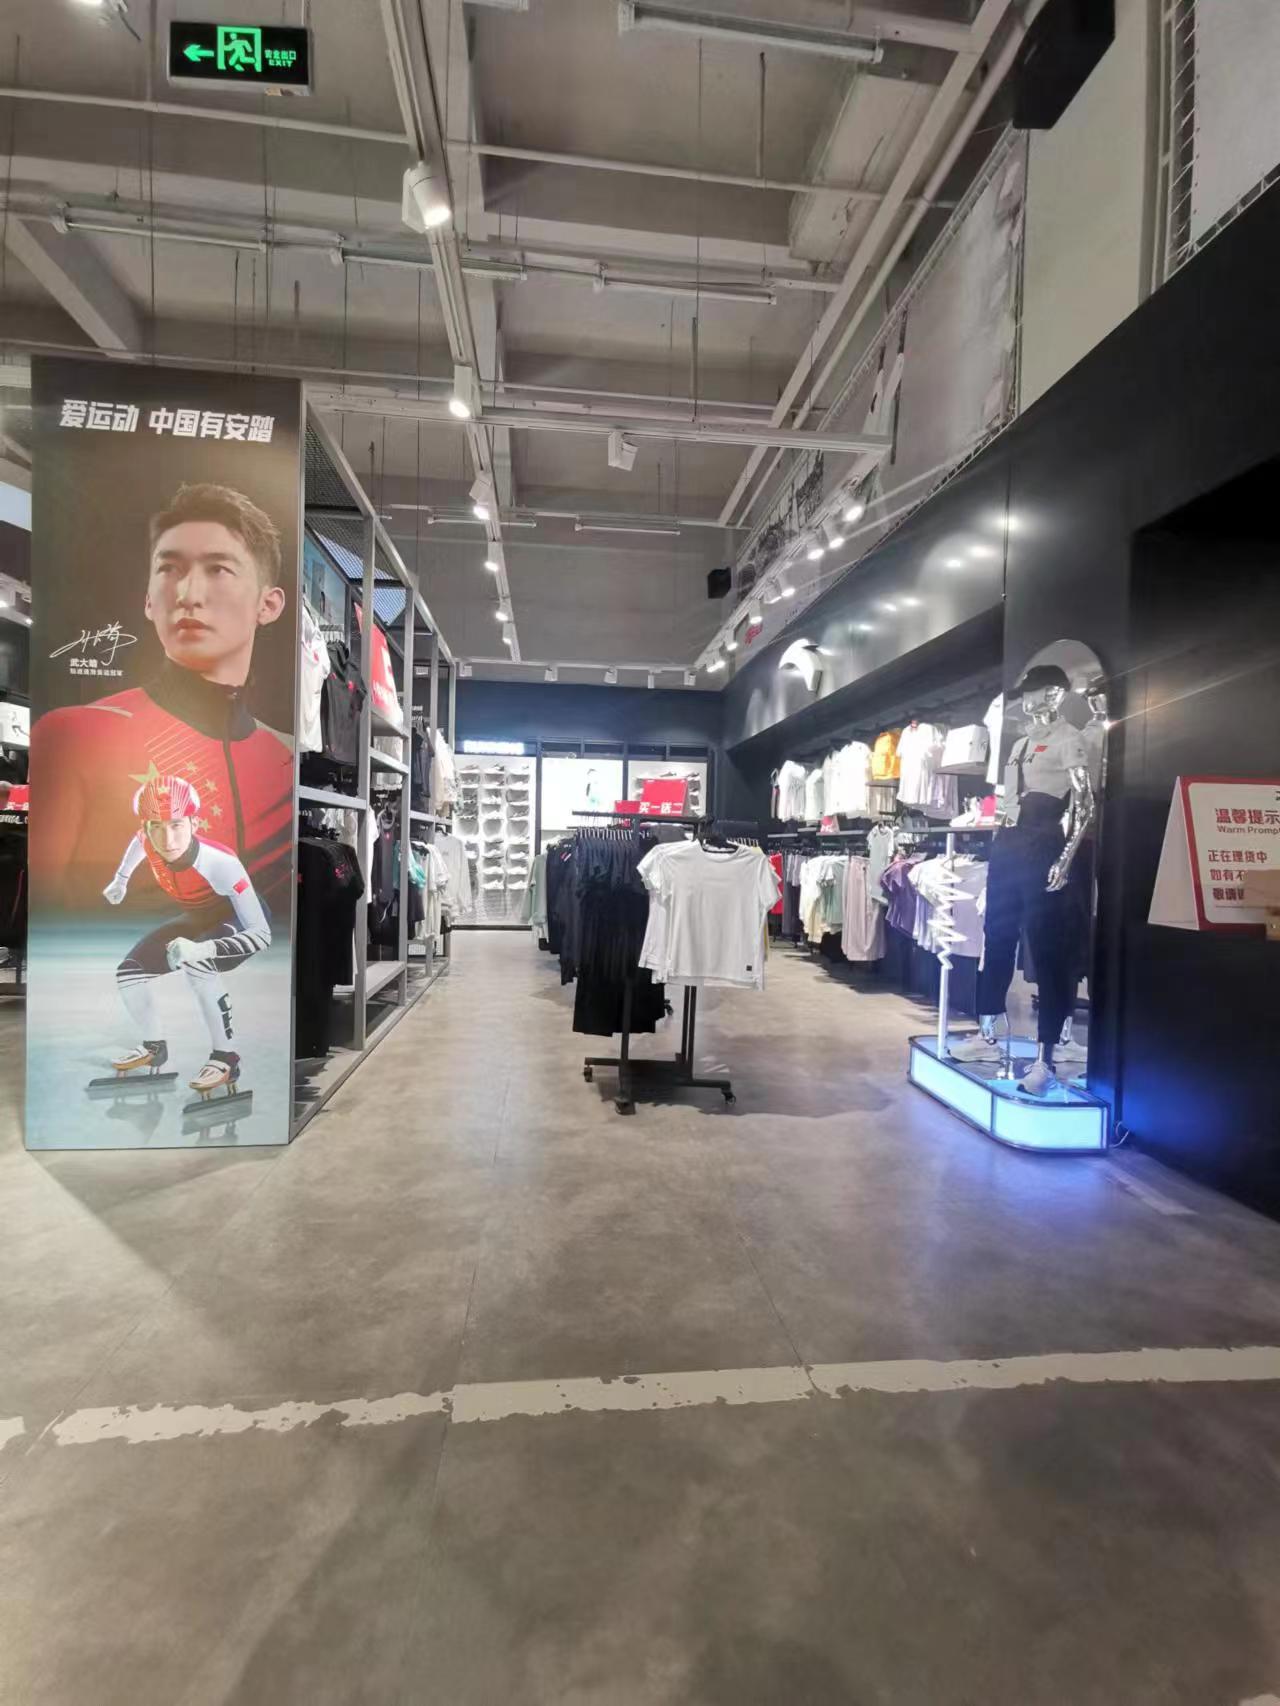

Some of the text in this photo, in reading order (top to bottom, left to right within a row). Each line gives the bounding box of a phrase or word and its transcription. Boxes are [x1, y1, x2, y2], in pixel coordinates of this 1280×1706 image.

[268, 59, 293, 67] EXIT
[60, 399, 275, 443] 爱运动 中国有安踏
[1215, 808, 1280, 824] 温馨提示
[1216, 825, 1246, 833] Warm
[1208, 850, 1267, 863] 正在理货中
